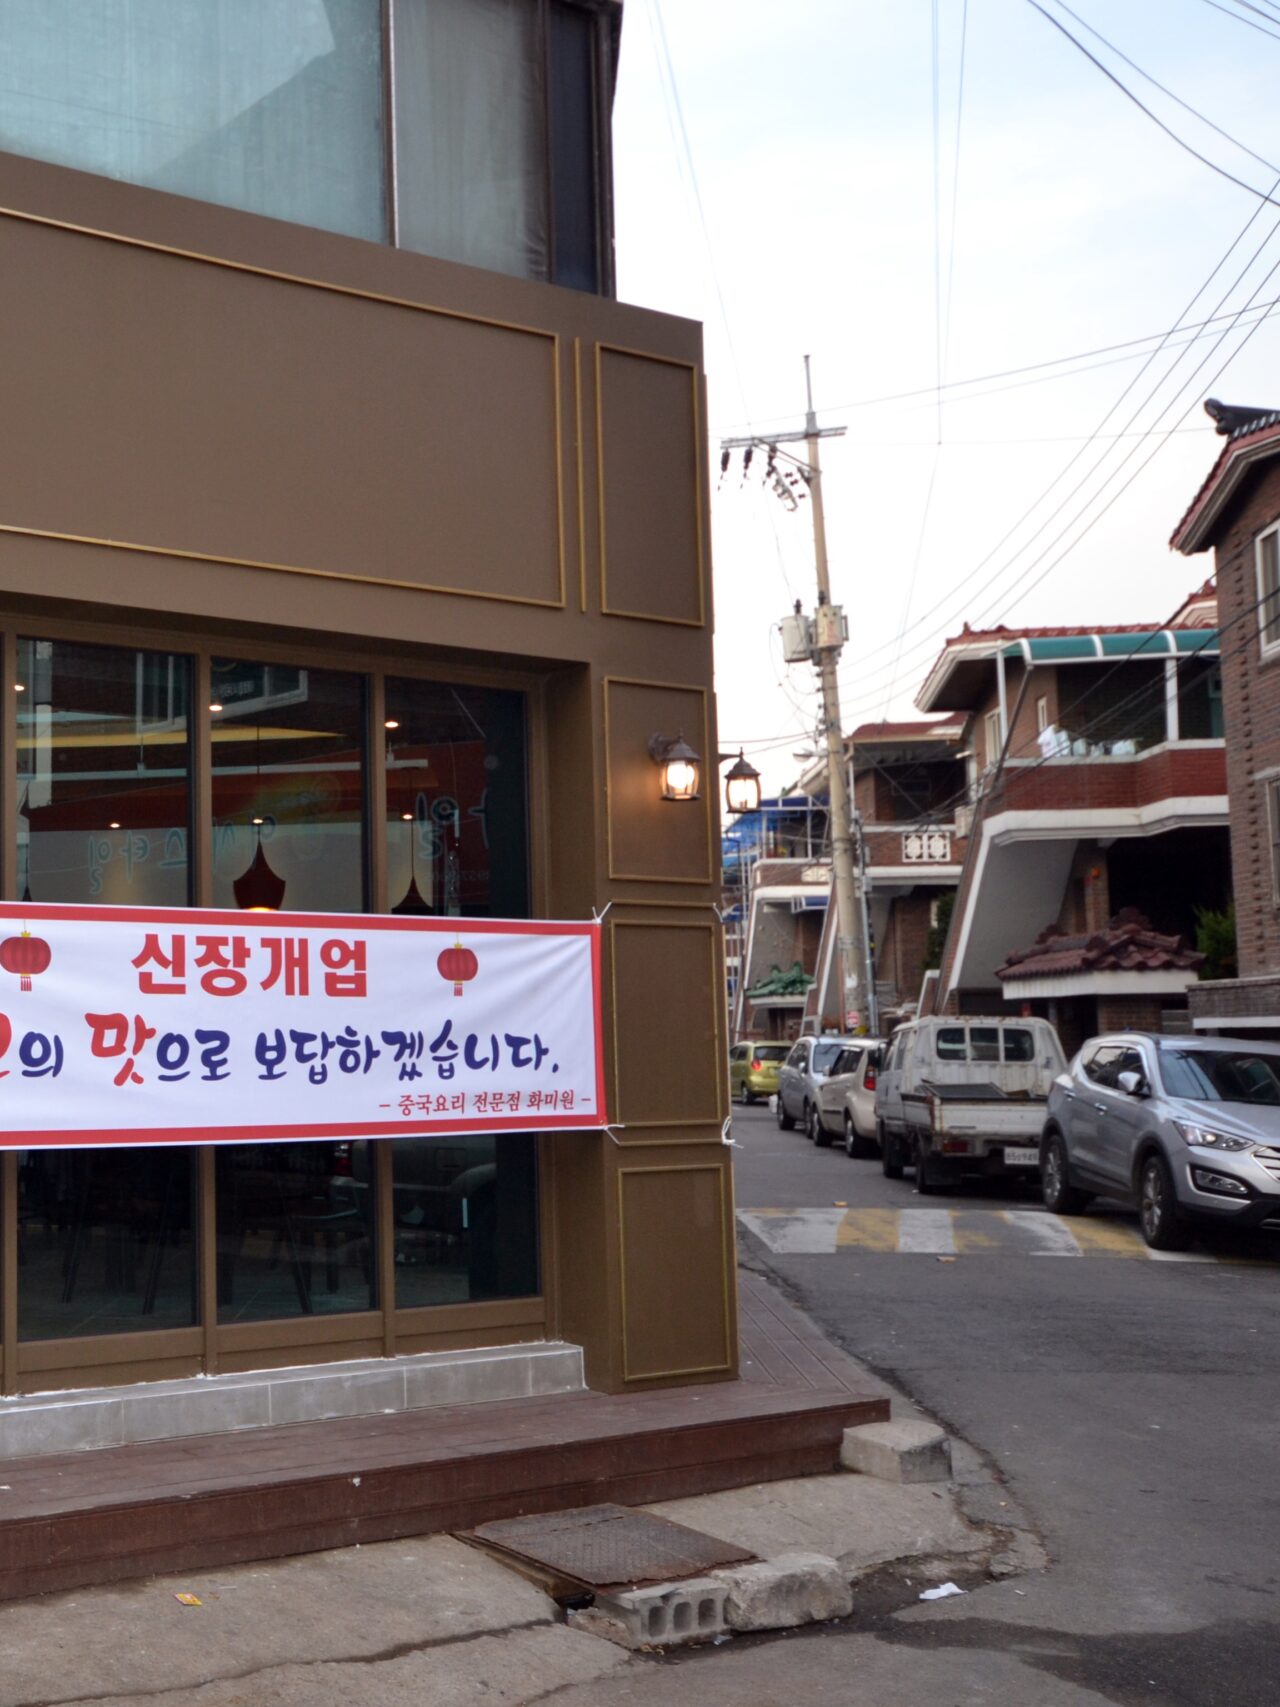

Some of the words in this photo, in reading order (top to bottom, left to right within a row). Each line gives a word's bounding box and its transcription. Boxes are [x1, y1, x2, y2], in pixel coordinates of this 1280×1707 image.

[131, 933, 367, 997] 신장개업
[85, 1012, 231, 1086] 맛으로
[255, 1019, 559, 1085] 보답하겠습니다.
[397, 1092, 465, 1116] 중국요리
[472, 1090, 521, 1113] 전문점
[527, 1089, 575, 1111] 화미원
